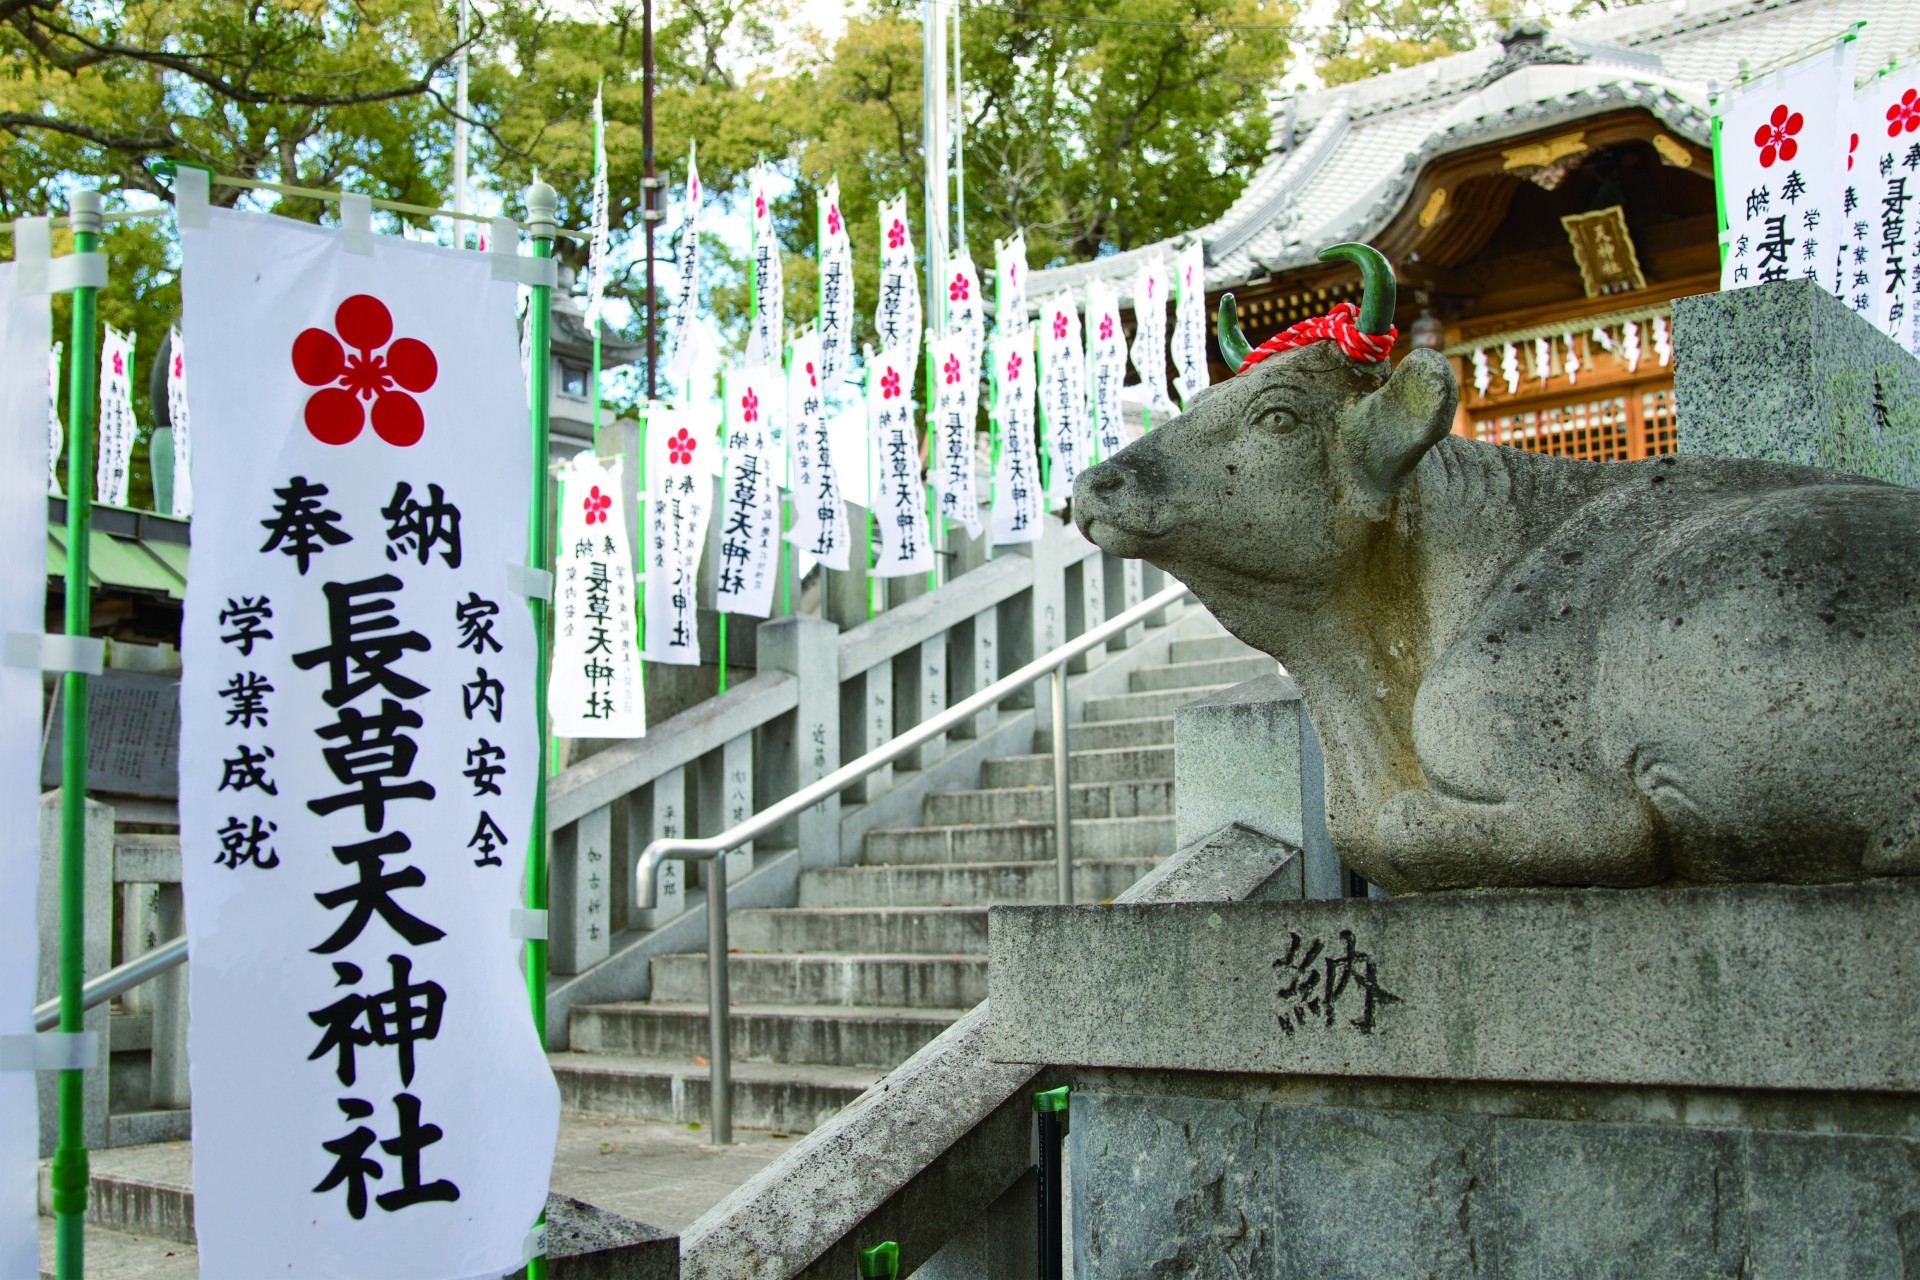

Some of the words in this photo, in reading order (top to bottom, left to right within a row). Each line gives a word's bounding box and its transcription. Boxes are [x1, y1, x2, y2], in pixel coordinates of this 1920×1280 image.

[260, 476, 462, 575] 奉納
[215, 597, 279, 869] 学業成就
[456, 592, 508, 868] 家内安全
[292, 574, 460, 1219] 長草天神社
[1273, 929, 1404, 1035] 納
